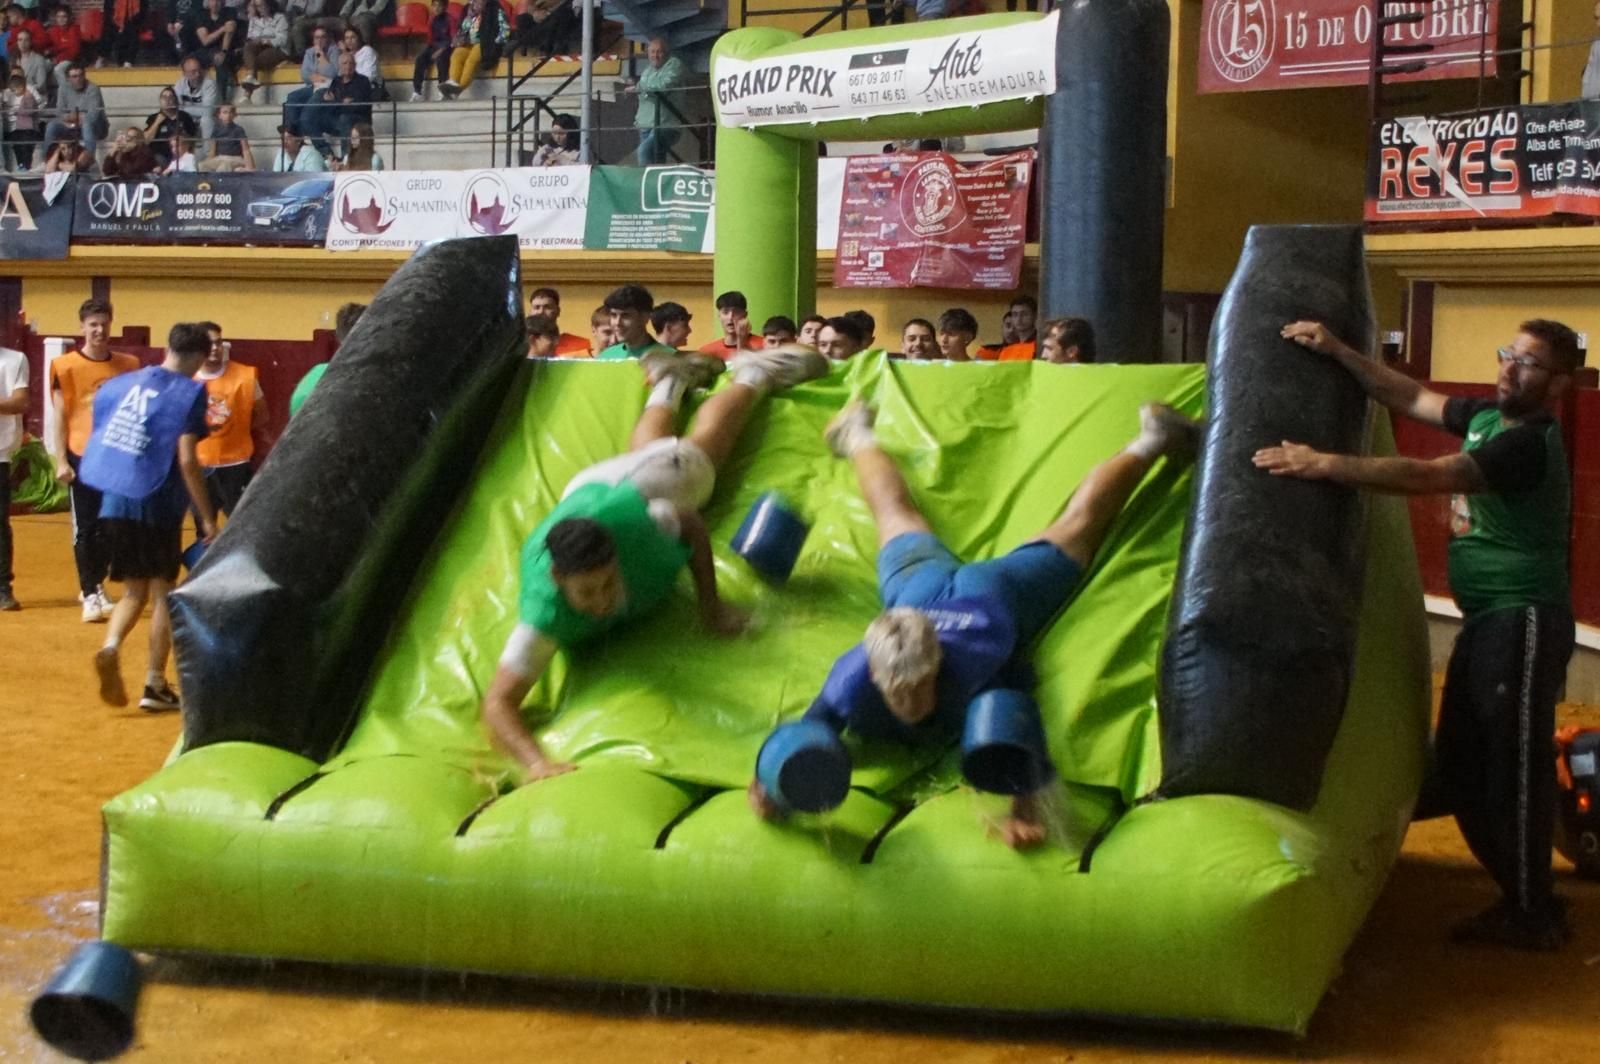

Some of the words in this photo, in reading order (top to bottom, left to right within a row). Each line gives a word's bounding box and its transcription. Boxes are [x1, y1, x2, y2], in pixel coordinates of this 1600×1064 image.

[1217, 0, 1263, 60] 15
[1284, 10, 1308, 50] 15
[1317, 17, 1345, 47] DE
[1353, 0, 1490, 44] OTUBRE
[717, 65, 782, 106] GRAND
[785, 64, 837, 98] PRIX
[849, 74, 865, 87] 667
[867, 73, 878, 85] 09
[880, 71, 890, 83] 20
[893, 70, 904, 82] 17
[850, 91, 867, 105] 643
[869, 91, 879, 102] 77
[883, 90, 893, 101] 46
[895, 89, 906, 101] 63
[746, 104, 773, 117] Humor
[776, 102, 808, 115] Amarillo
[1381, 112, 1518, 145] ELECTRICIDAD
[1526, 138, 1547, 152] Alba
[1548, 137, 1561, 150] de
[1380, 138, 1519, 199] REYES
[1528, 162, 1554, 182] Telf
[406, 178, 442, 191] GRUPO
[529, 174, 569, 188] GRUPO
[0, 181, 39, 230] A
[116, 183, 160, 217] MP
[176, 193, 194, 205] 608
[176, 209, 194, 220] 609
[195, 208, 212, 219] 433
[214, 208, 232, 220] 032
[132, 223, 161, 231] PAULA
[331, 238, 405, 248] CONSTRUCCIONES
[540, 237, 585, 246] REFORMAS
